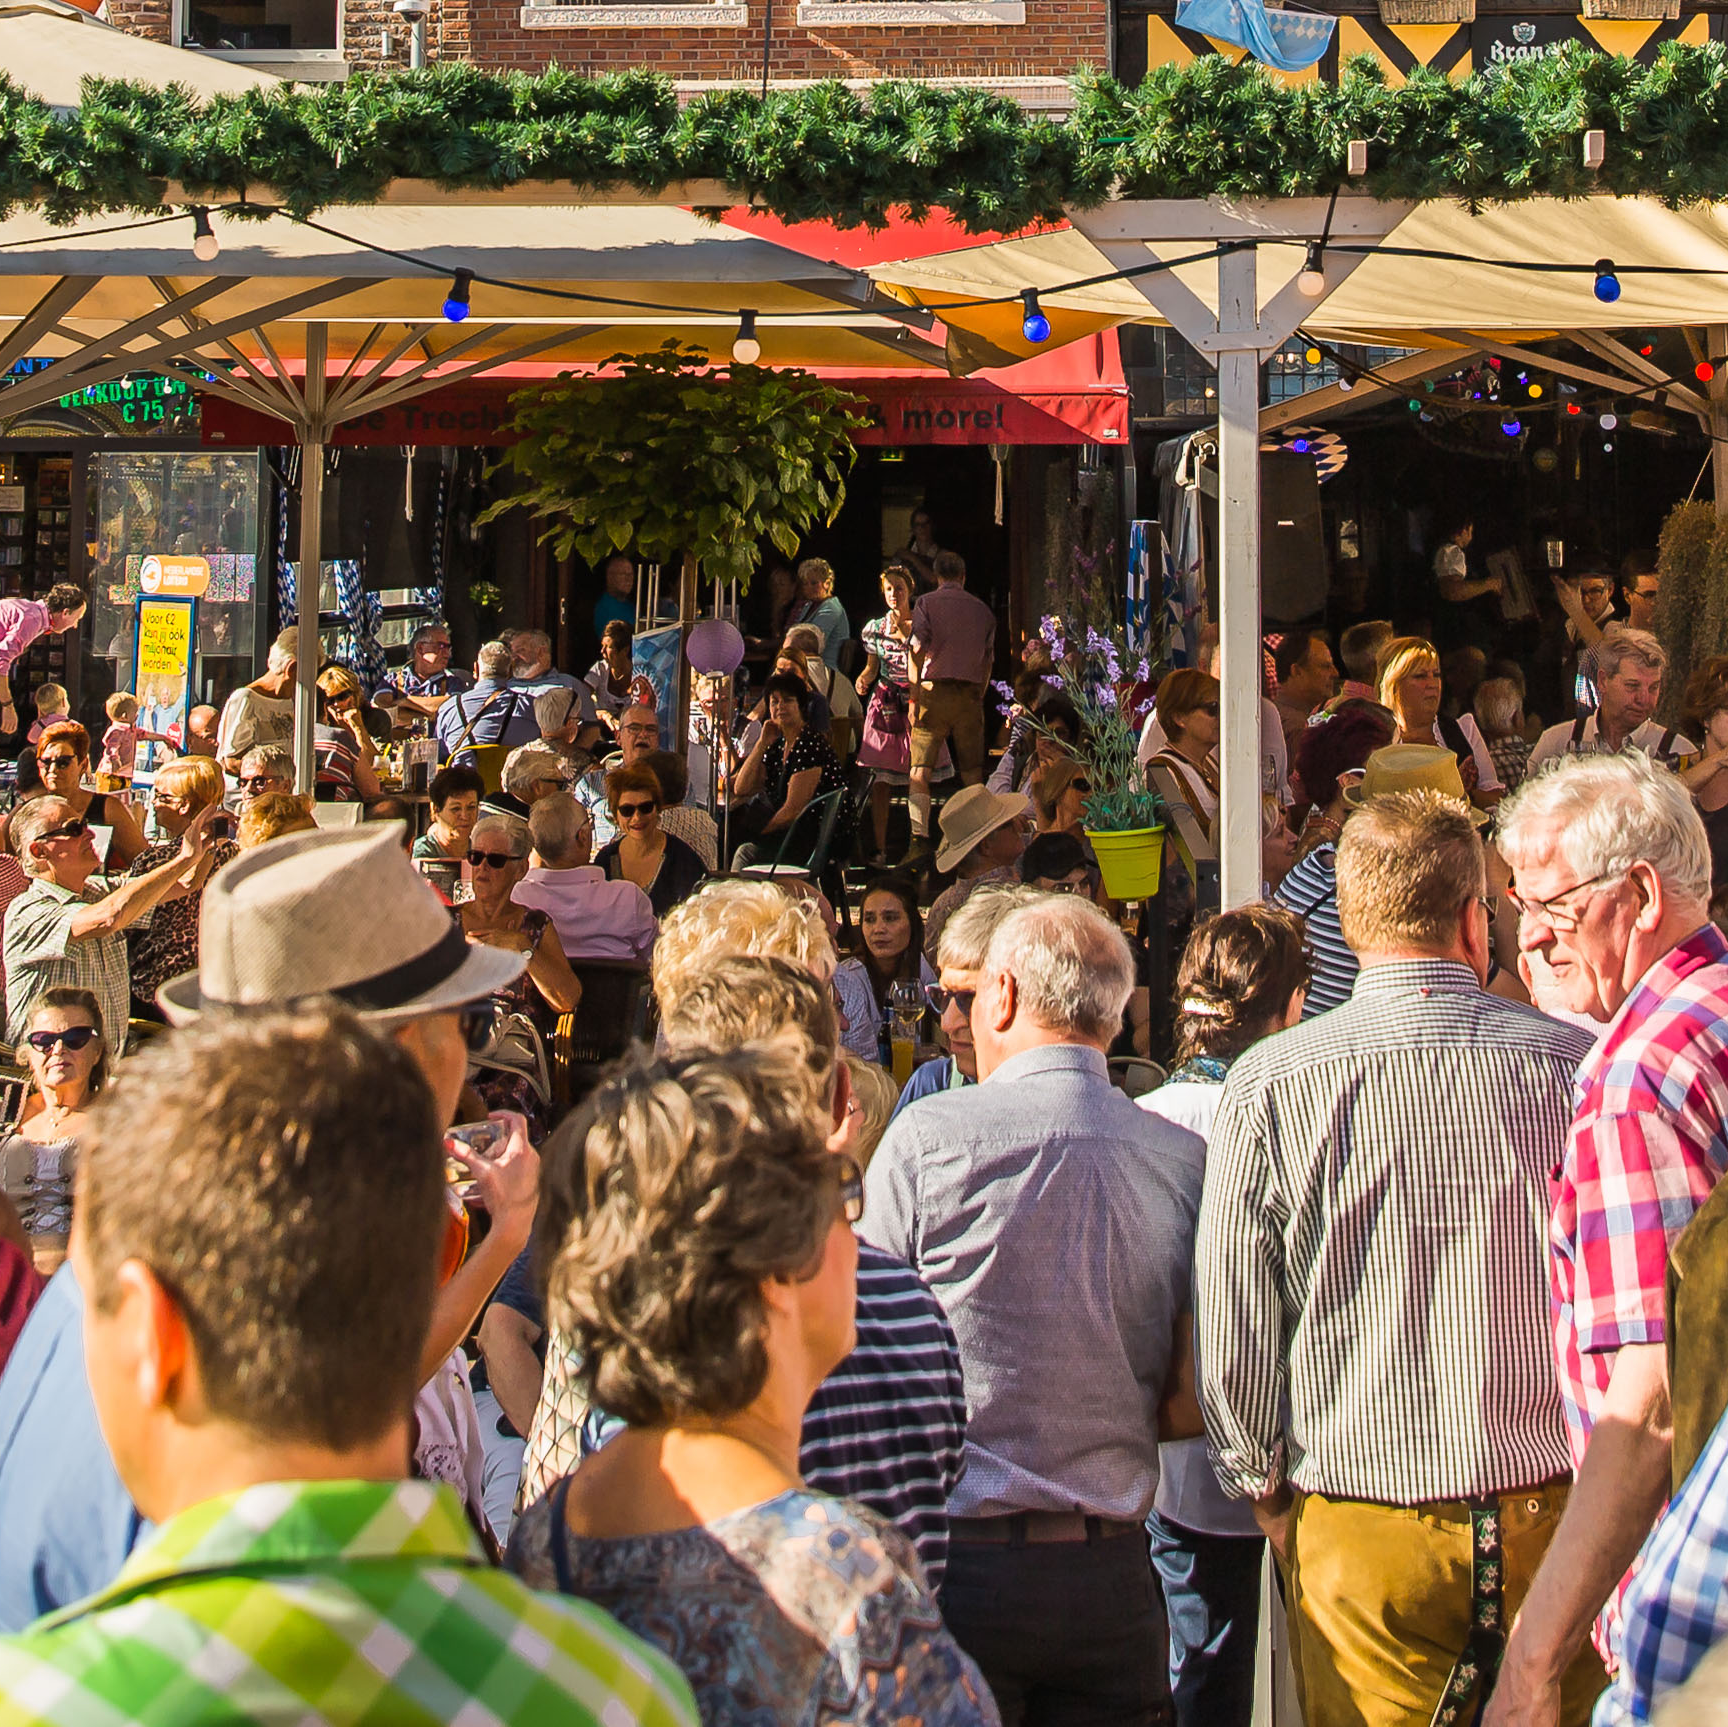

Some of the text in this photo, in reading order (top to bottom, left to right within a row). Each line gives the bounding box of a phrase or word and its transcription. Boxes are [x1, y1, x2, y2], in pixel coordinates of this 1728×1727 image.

[902, 403, 1005, 430] more!
[145, 612, 163, 625] Voor
[143, 658, 172, 670] worden
